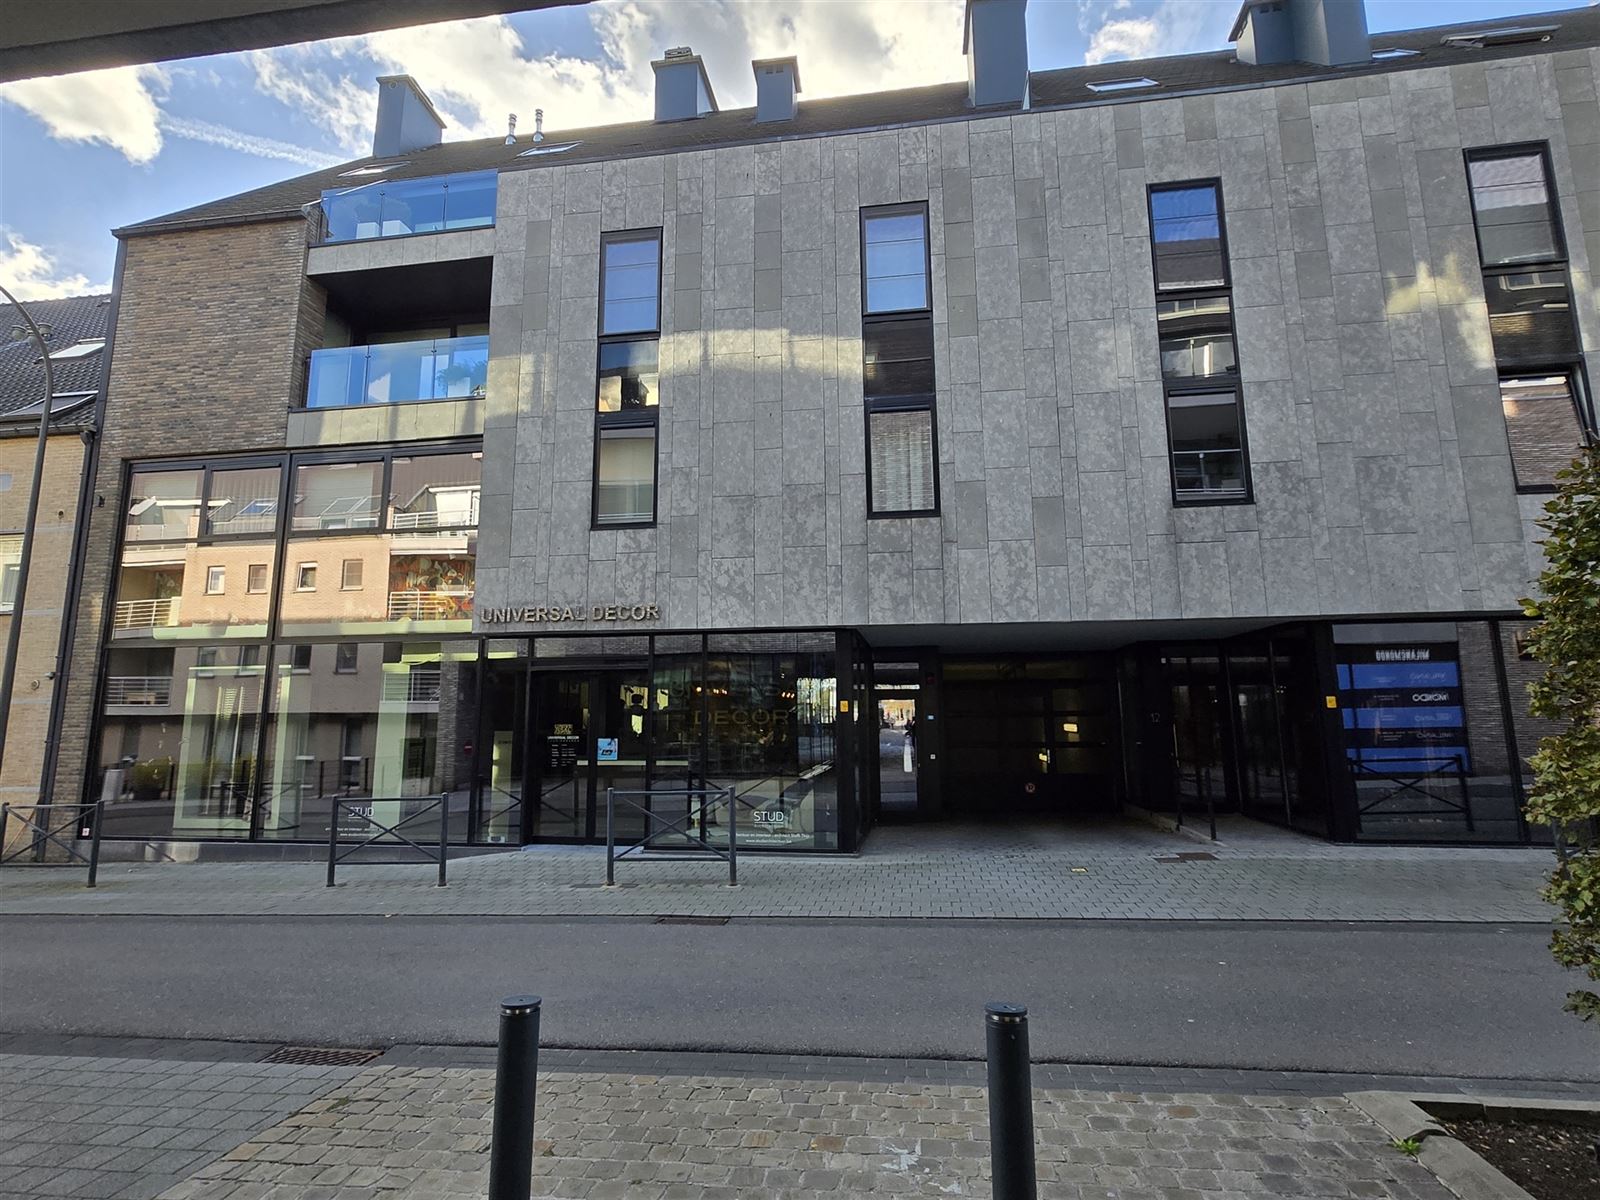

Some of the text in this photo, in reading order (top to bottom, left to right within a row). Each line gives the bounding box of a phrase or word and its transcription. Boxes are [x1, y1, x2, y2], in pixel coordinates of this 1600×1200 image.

[480, 604, 659, 623] UNIVERSAL DECOR
[694, 709, 789, 725] DECOR
[753, 811, 784, 822] STUD
